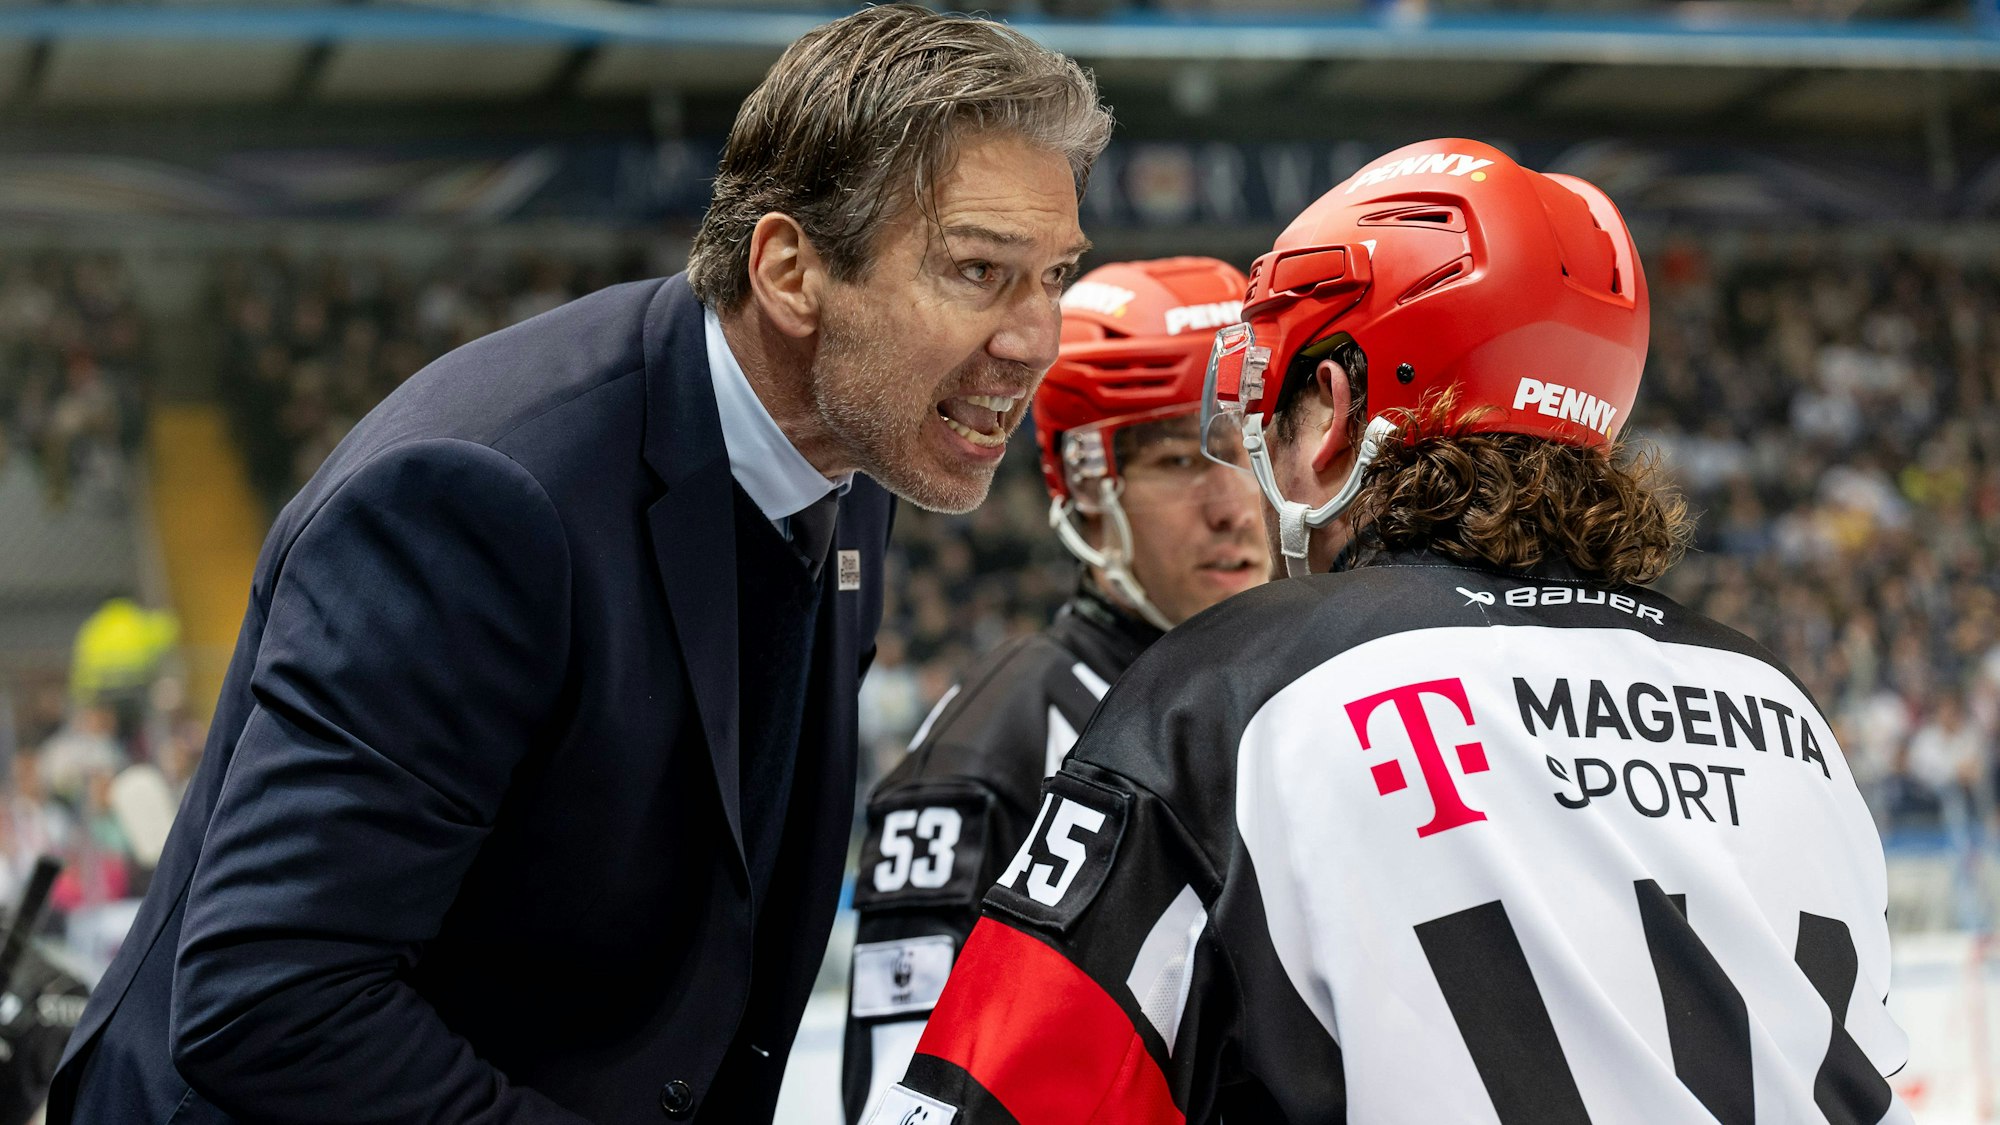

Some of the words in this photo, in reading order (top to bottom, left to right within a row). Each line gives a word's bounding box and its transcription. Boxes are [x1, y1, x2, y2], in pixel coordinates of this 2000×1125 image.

[1512, 676, 1832, 780] MAGENTA
[1546, 754, 1746, 826] SPORT
[873, 806, 962, 893] 53
